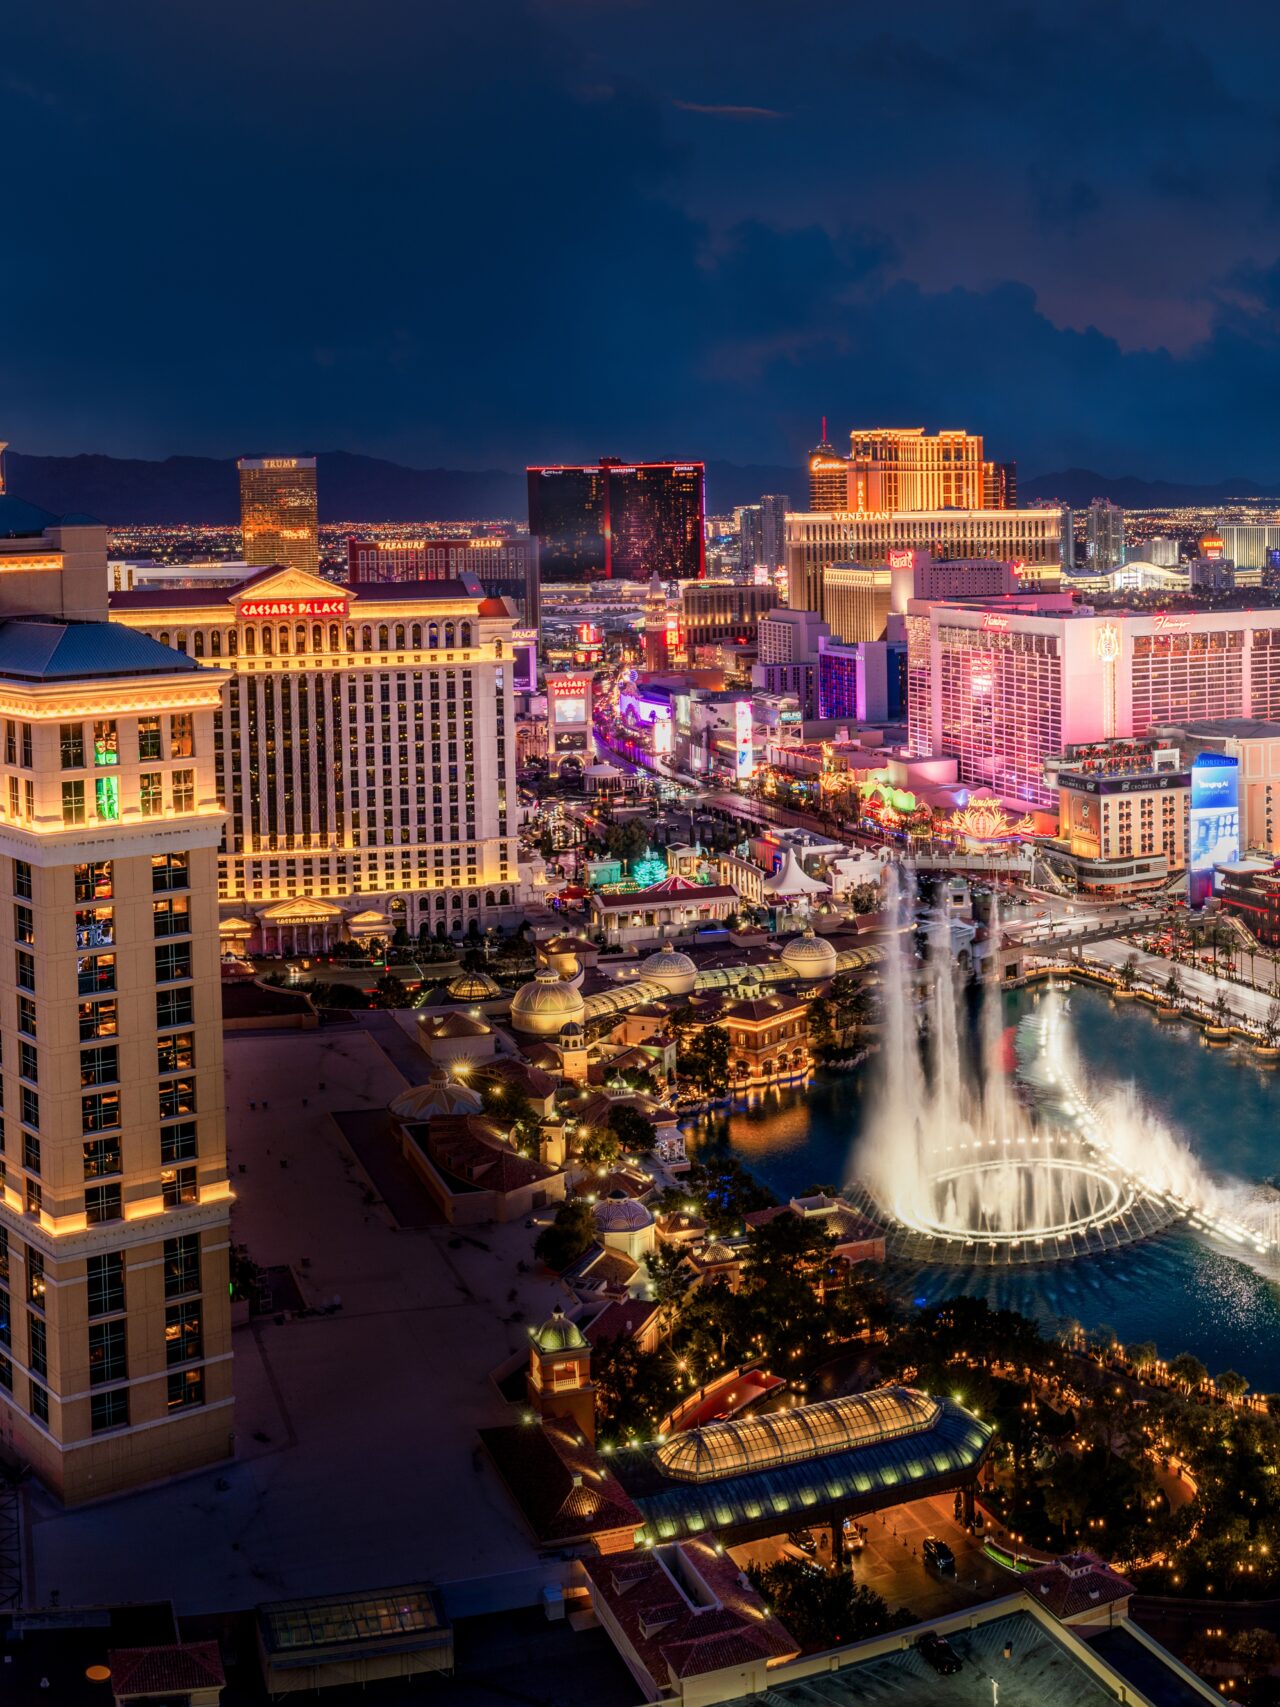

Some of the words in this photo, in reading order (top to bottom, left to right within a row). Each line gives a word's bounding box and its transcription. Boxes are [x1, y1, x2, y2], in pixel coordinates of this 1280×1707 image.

[263, 460, 297, 468] TRUMP
[834, 511, 890, 521] VENETIAN
[378, 541, 426, 550] TREASURE
[470, 540, 502, 548] ISLAND
[241, 603, 295, 616] CAESARS
[299, 602, 345, 614] PALACE
[983, 612, 1009, 630] Flamingo
[1153, 616, 1191, 631] Flamingo
[511, 630, 537, 639] IRAGE
[553, 680, 586, 688] CAESARS
[554, 688, 585, 696] PALACE
[968, 794, 1003, 808] Flamingo
